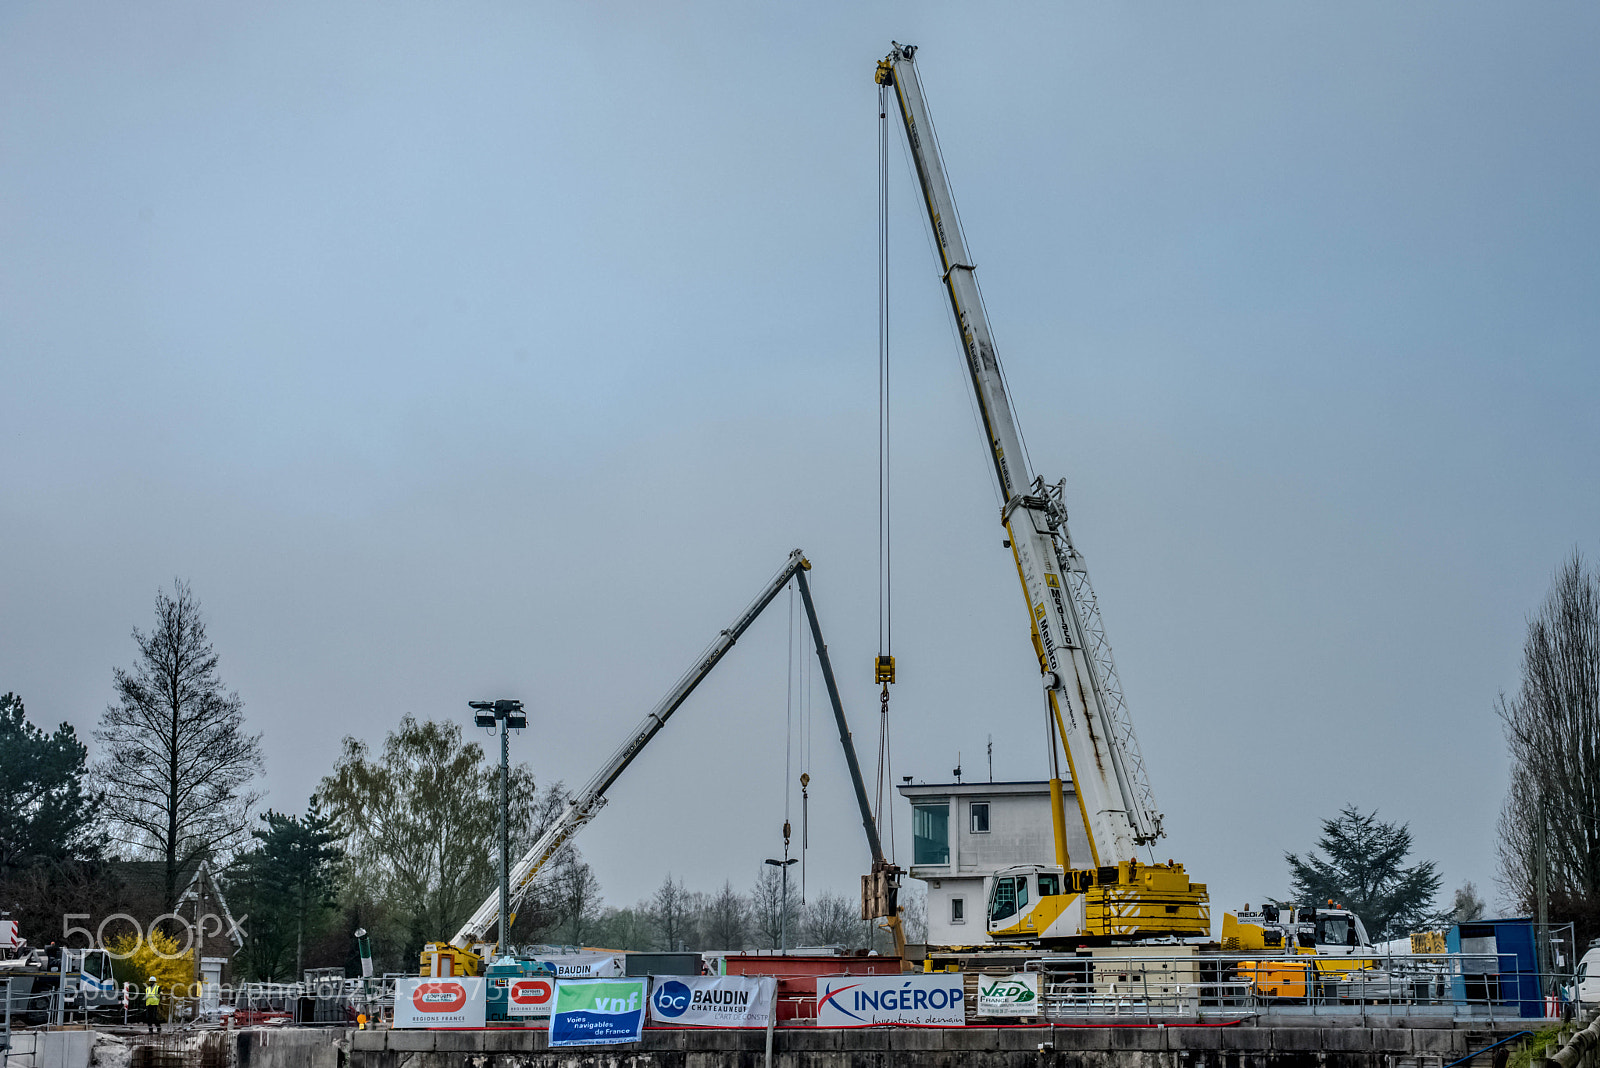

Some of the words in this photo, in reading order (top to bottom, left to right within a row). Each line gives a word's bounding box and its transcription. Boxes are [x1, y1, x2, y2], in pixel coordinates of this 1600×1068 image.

[968, 342, 980, 374] Mediaco
[999, 457, 1012, 490] Mediaco
[1040, 618, 1058, 670] Mediaco
[558, 965, 591, 975] BAUDIN
[658, 984, 686, 1010] bc
[854, 981, 963, 1011] INGÉROP
[980, 981, 1020, 997] VRD
[595, 992, 638, 1013] vnf
[693, 990, 748, 1005] BAUDIN
[691, 1005, 748, 1013] CHATEAUNEUF
[566, 1016, 587, 1024] Voies
[574, 1020, 614, 1030] navigables
[872, 1013, 920, 1024] Inventons
[925, 1014, 964, 1024] demain
